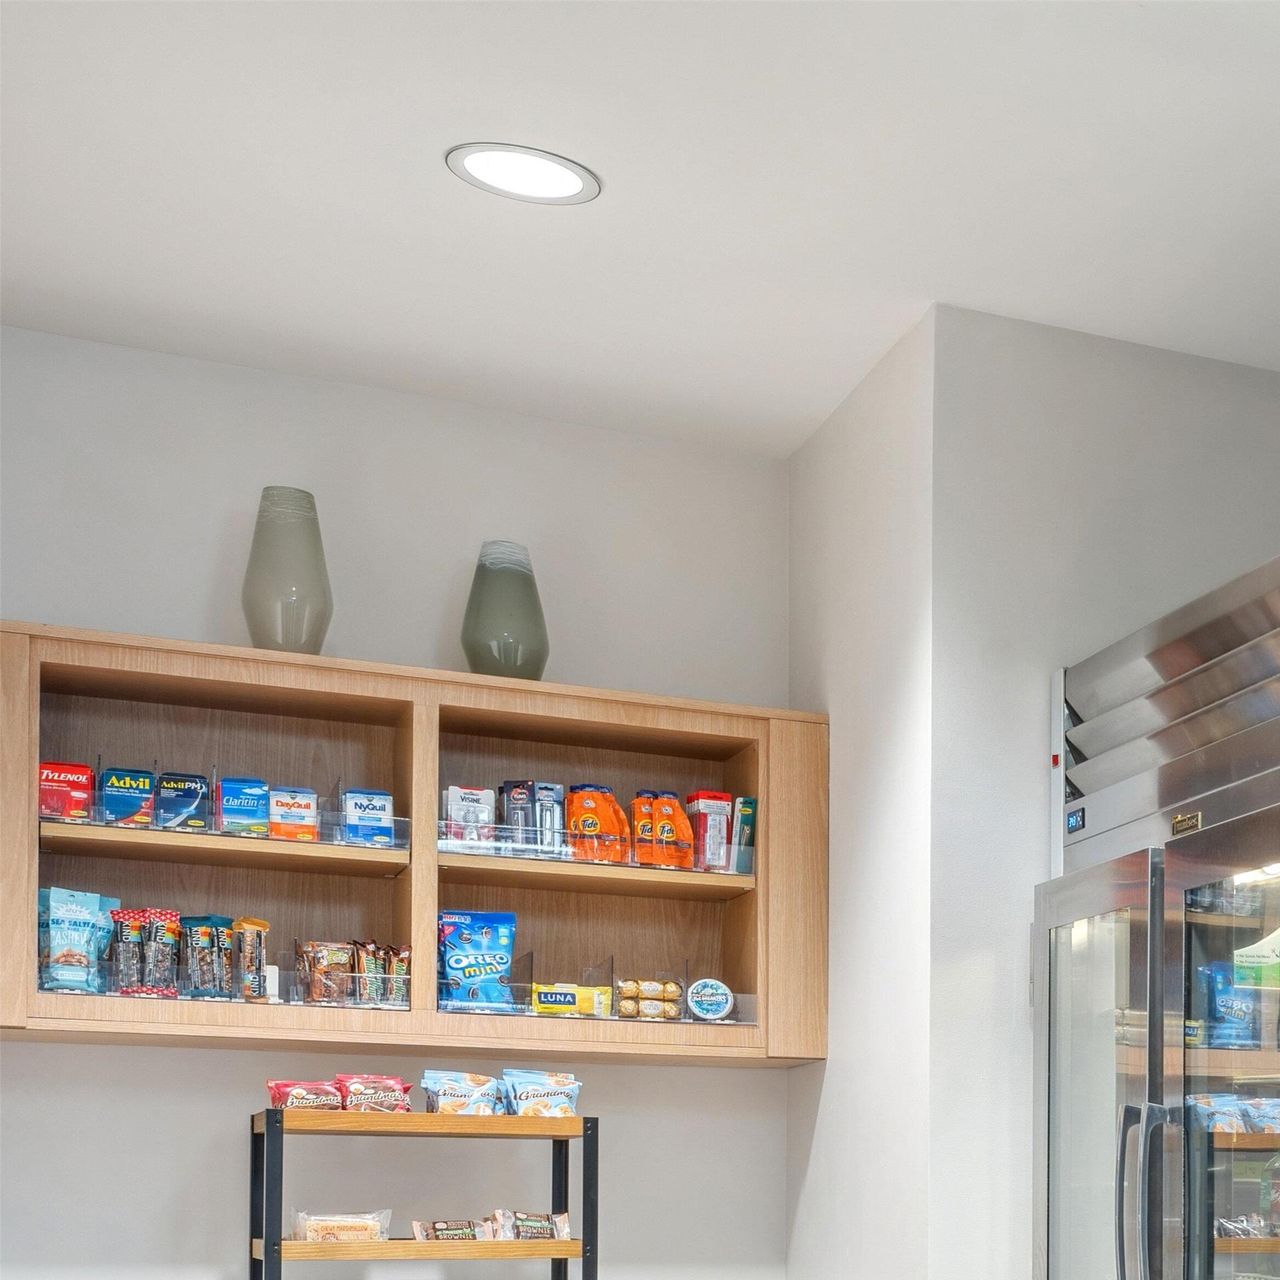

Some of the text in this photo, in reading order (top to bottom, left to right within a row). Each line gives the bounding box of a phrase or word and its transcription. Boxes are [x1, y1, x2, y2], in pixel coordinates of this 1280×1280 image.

[41, 769, 89, 783] TYLENOL
[107, 775, 150, 789] Advil
[223, 796, 258, 807] Claritin
[275, 800, 311, 811] DayQuil
[354, 802, 387, 813] NyQuil
[580, 818, 600, 831] Tide
[122, 921, 131, 942] KIND
[156, 920, 167, 943] KIND
[449, 954, 508, 969] OREO
[541, 993, 574, 1003] LUNA
